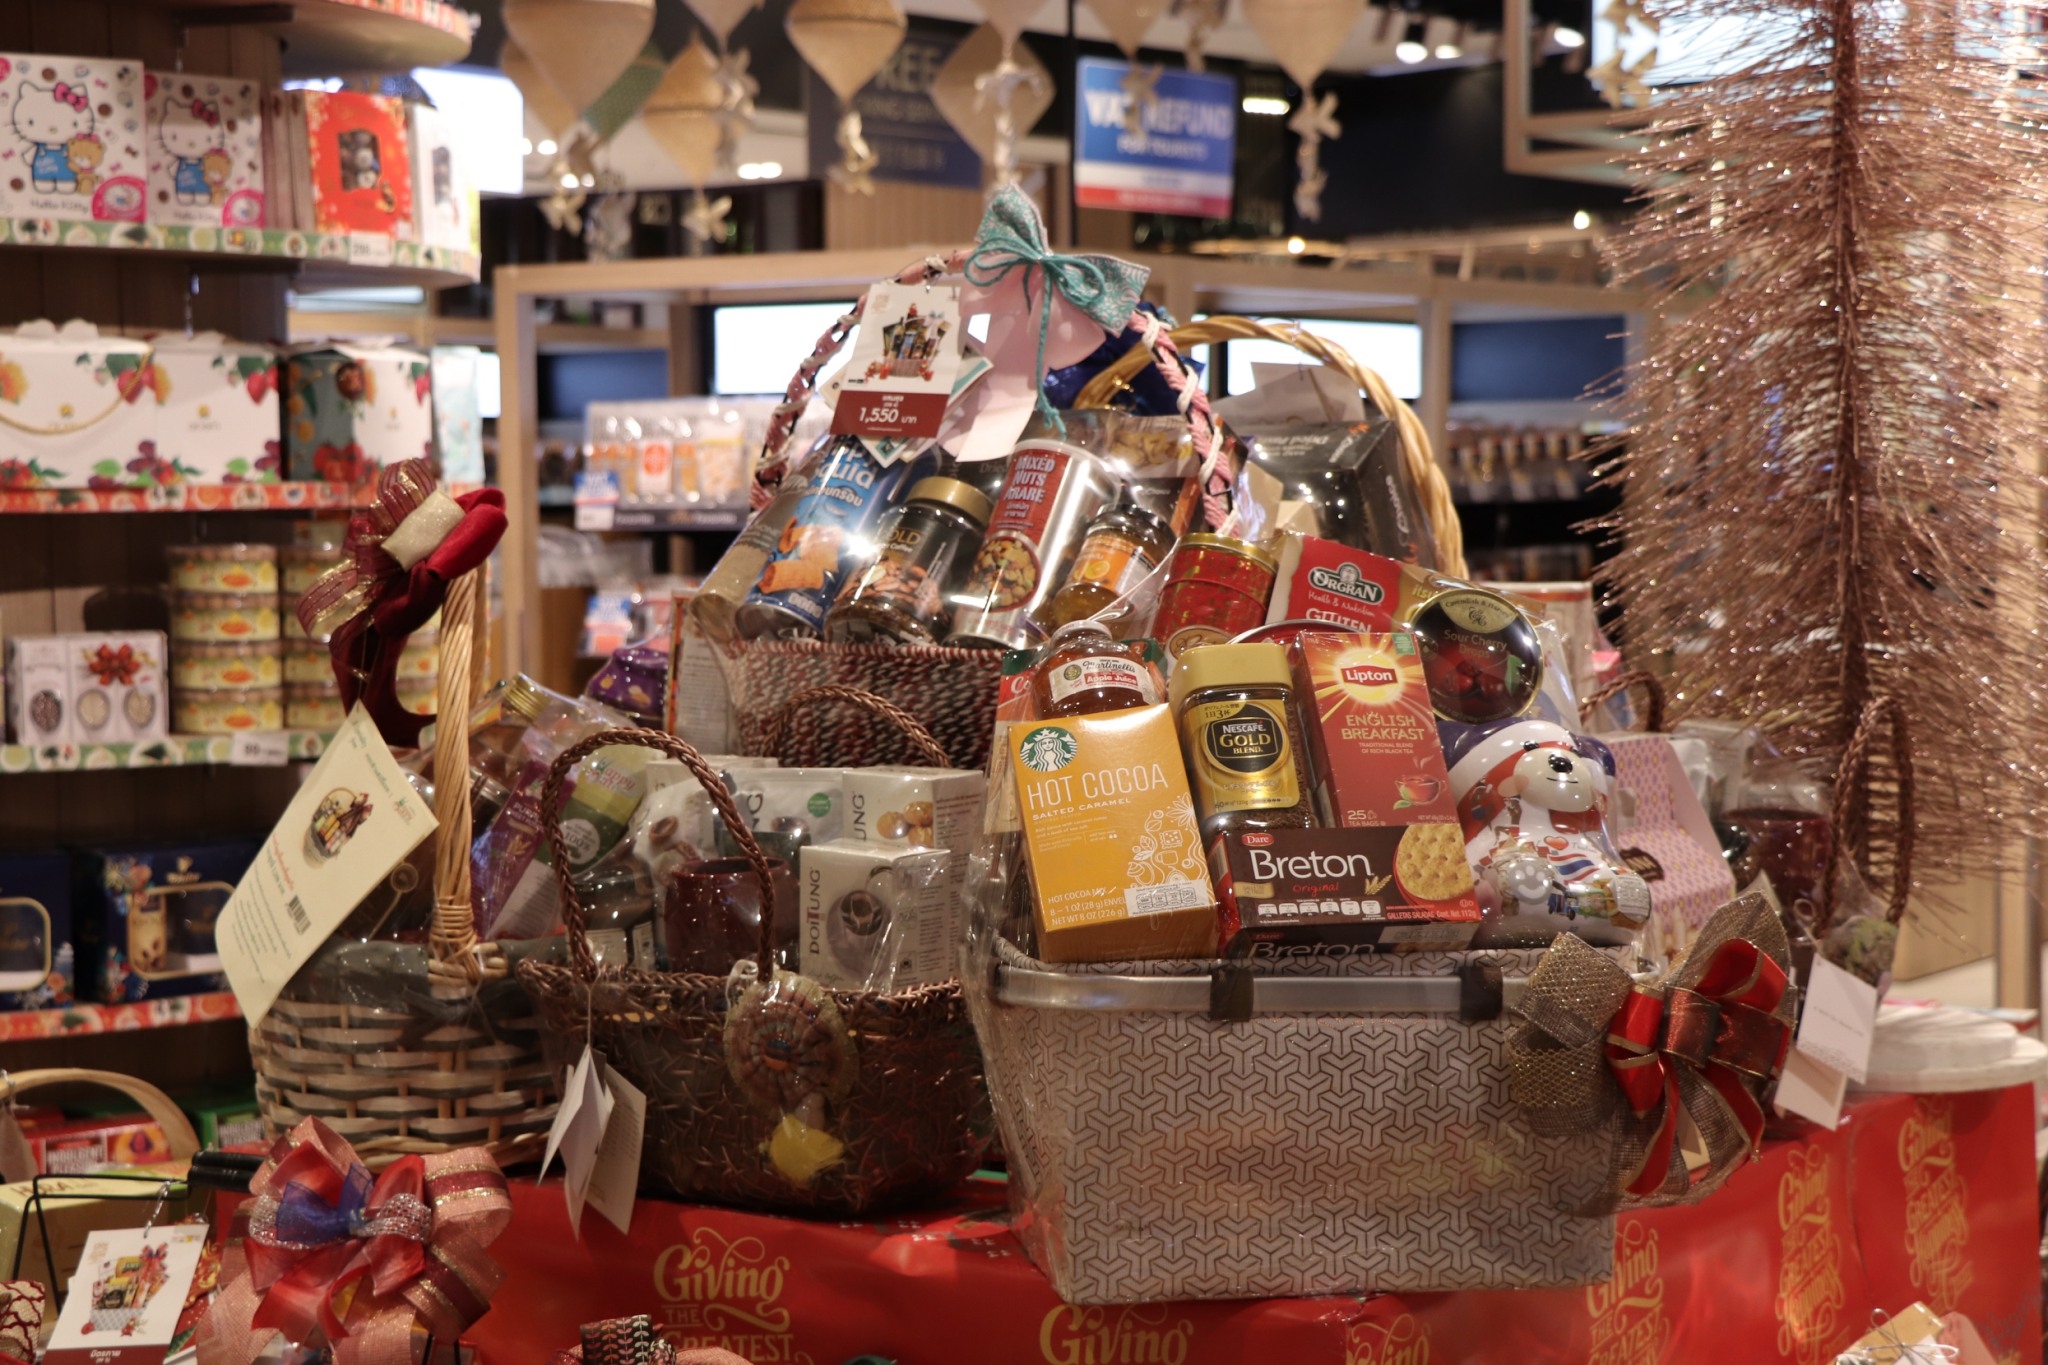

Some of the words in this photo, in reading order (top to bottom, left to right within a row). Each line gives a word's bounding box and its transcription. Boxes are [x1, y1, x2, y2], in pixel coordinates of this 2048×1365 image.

[1084, 89, 1133, 128] VA
[858, 407, 899, 424] 1,550
[1015, 455, 1056, 472] MIXED
[1012, 470, 1047, 487] NUTS
[886, 529, 921, 545] OLD
[1313, 569, 1379, 602] ORGRAN
[1308, 590, 1331, 605] Health
[1444, 629, 1470, 642] Sour
[1471, 634, 1508, 651] Cherry
[1459, 643, 1491, 659] Drops
[1086, 674, 1113, 683] Apple
[1114, 675, 1137, 685] Juice
[1346, 669, 1393, 683] Lipton
[1346, 712, 1416, 727] ENGLISH
[1219, 733, 1271, 747] GOLD
[1341, 728, 1425, 741] BREAKFAST
[1233, 746, 1262, 754] BLEND
[1027, 775, 1073, 810] HOT
[1082, 763, 1169, 799] COCOA
[1032, 807, 1075, 821] SALTED
[1078, 798, 1132, 811] CARAMEL
[1347, 810, 1367, 820] 25
[1246, 835, 1269, 844] Dare
[1249, 850, 1372, 880] Breton
[1048, 894, 1063, 904] HOT
[1064, 890, 1091, 901] COCOA
[1292, 882, 1339, 897] Original
[1070, 903, 1081, 912] OZ
[1082, 900, 1095, 911] (28
[1096, 899, 1104, 909] g)
[1052, 916, 1066, 926] NET
[1067, 915, 1080, 923] WT
[1081, 913, 1086, 921] 8
[1086, 912, 1097, 920] OZ
[1098, 909, 1116, 919] (226
[1117, 908, 1126, 917] g)
[1387, 912, 1412, 920] GALLETAS
[1412, 911, 1435, 919] SALADAS
[1461, 909, 1477, 918] 112g
[1247, 942, 1375, 959] Breton
[653, 1228, 790, 1310] Giving
[664, 1308, 701, 1324] THE
[1039, 1301, 1195, 1365] Giving
